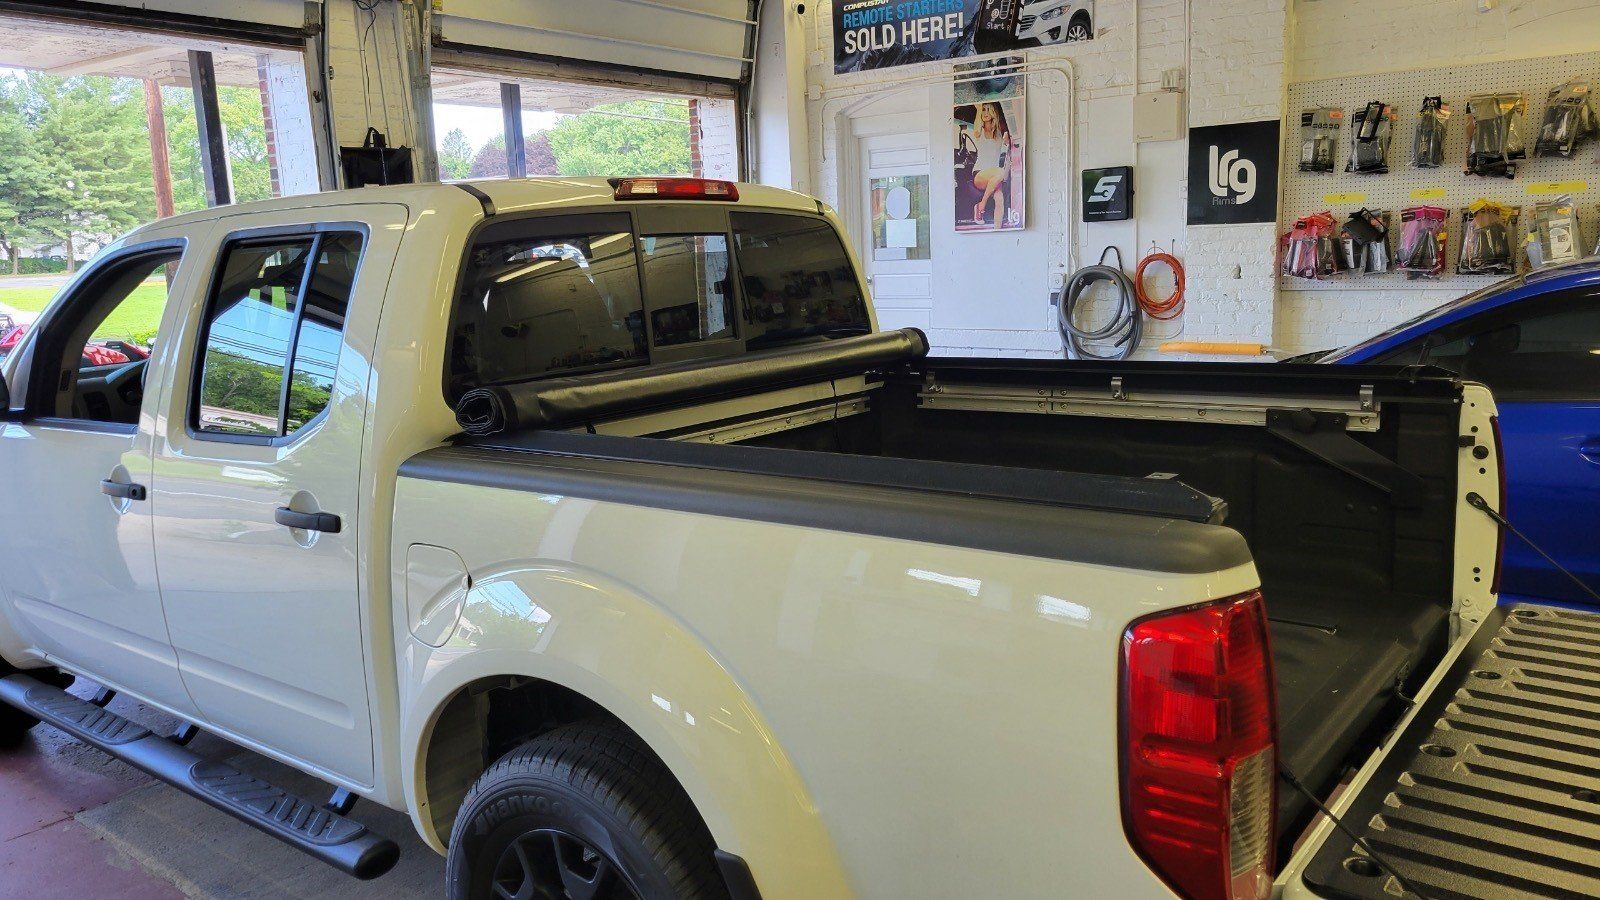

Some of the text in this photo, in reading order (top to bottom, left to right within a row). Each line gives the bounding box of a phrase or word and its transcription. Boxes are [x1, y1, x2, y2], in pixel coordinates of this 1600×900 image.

[843, 0, 964, 28] REMOTE STARTERS
[844, 12, 964, 54] SOLD HERE!
[986, 22, 1005, 30] Start
[1212, 197, 1237, 206] Rims
